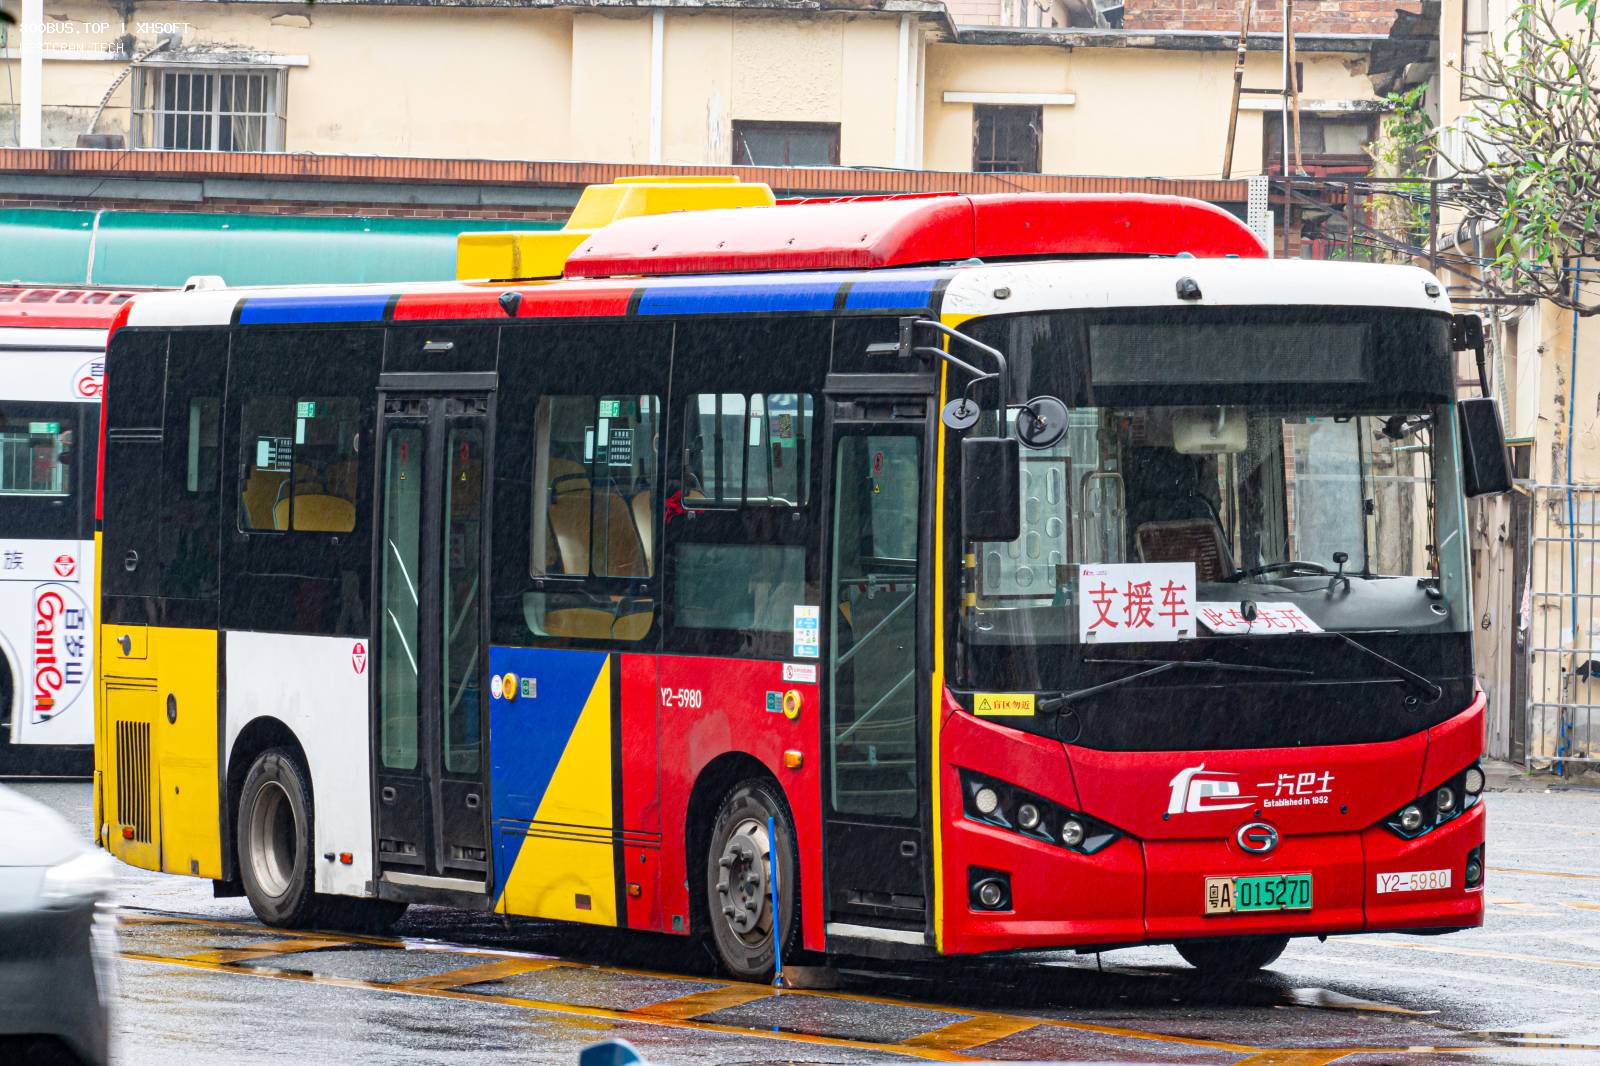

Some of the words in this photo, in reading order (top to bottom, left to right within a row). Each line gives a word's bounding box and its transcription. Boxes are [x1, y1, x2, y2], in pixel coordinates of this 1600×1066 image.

[3, 549, 24, 570] 族
[1088, 579, 1190, 630] 支援车
[64, 608, 86, 684] 百岁山
[660, 687, 702, 709] Y2-5980
[1256, 770, 1336, 797] 一汽巴士
[1263, 797, 1303, 808] Established
[1303, 797, 1310, 806] in
[1311, 796, 1329, 805] 1952
[1380, 870, 1448, 893] Y2-5980
